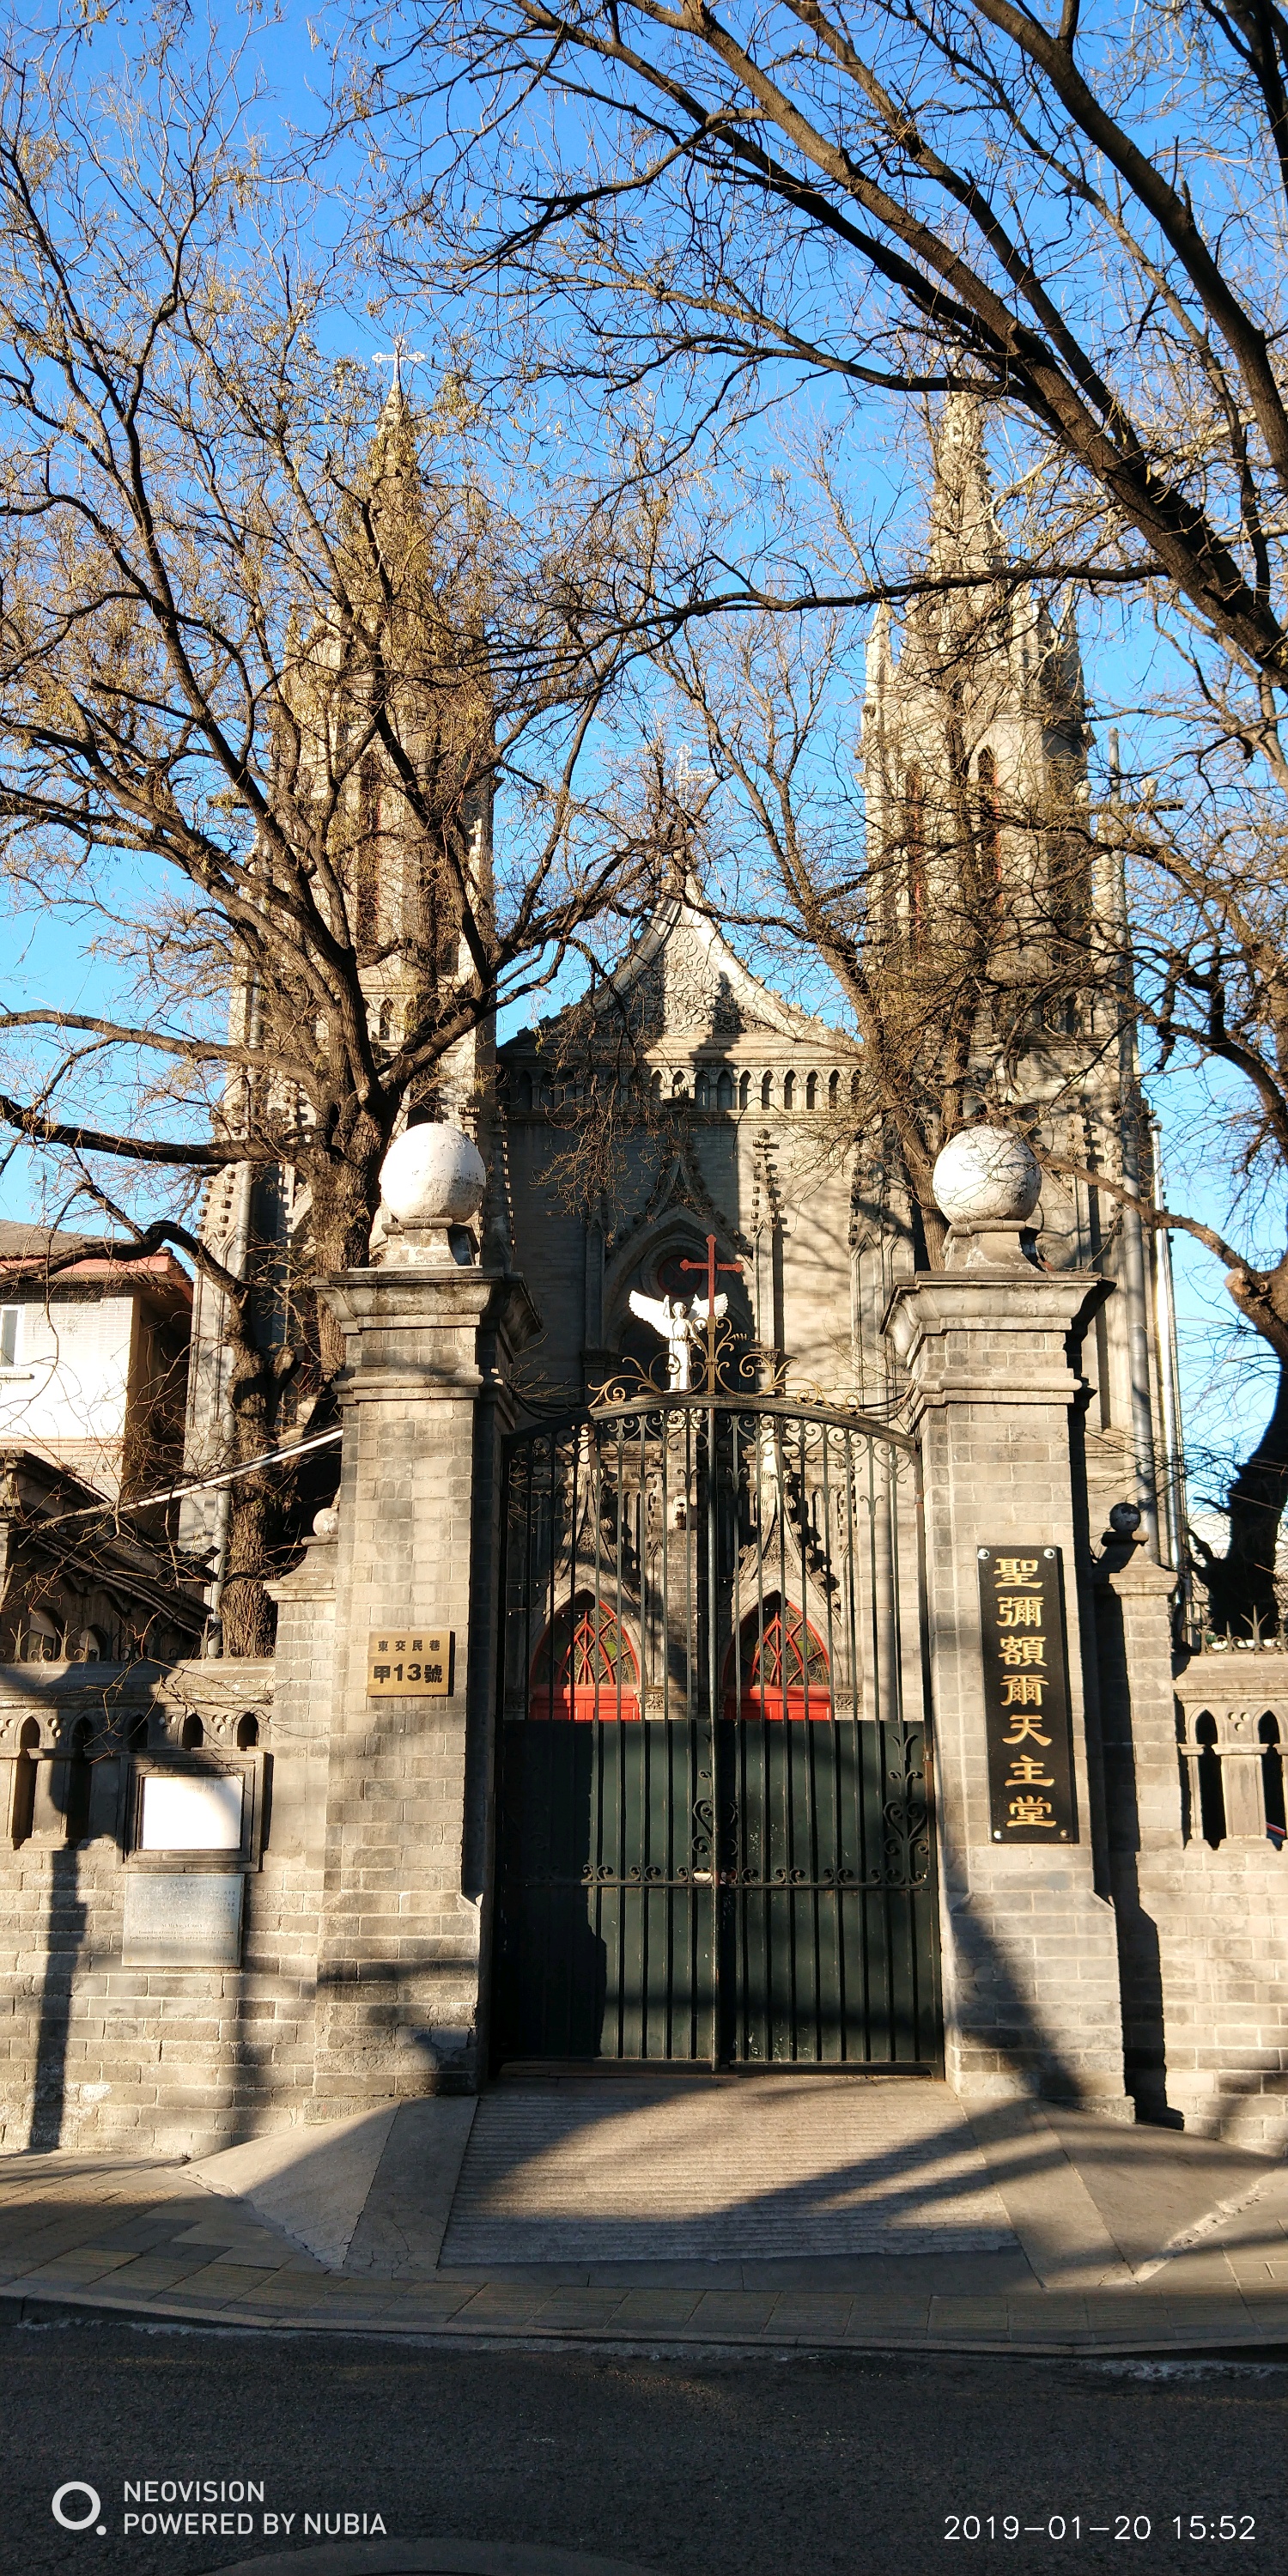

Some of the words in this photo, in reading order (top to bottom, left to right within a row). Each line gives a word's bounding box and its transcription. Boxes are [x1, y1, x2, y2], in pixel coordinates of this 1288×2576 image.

[378, 1639, 440, 1652] 東交民巷
[374, 1663, 443, 1684] 甲13號
[993, 1557, 1057, 1827] 聖彌額爾天主堂
